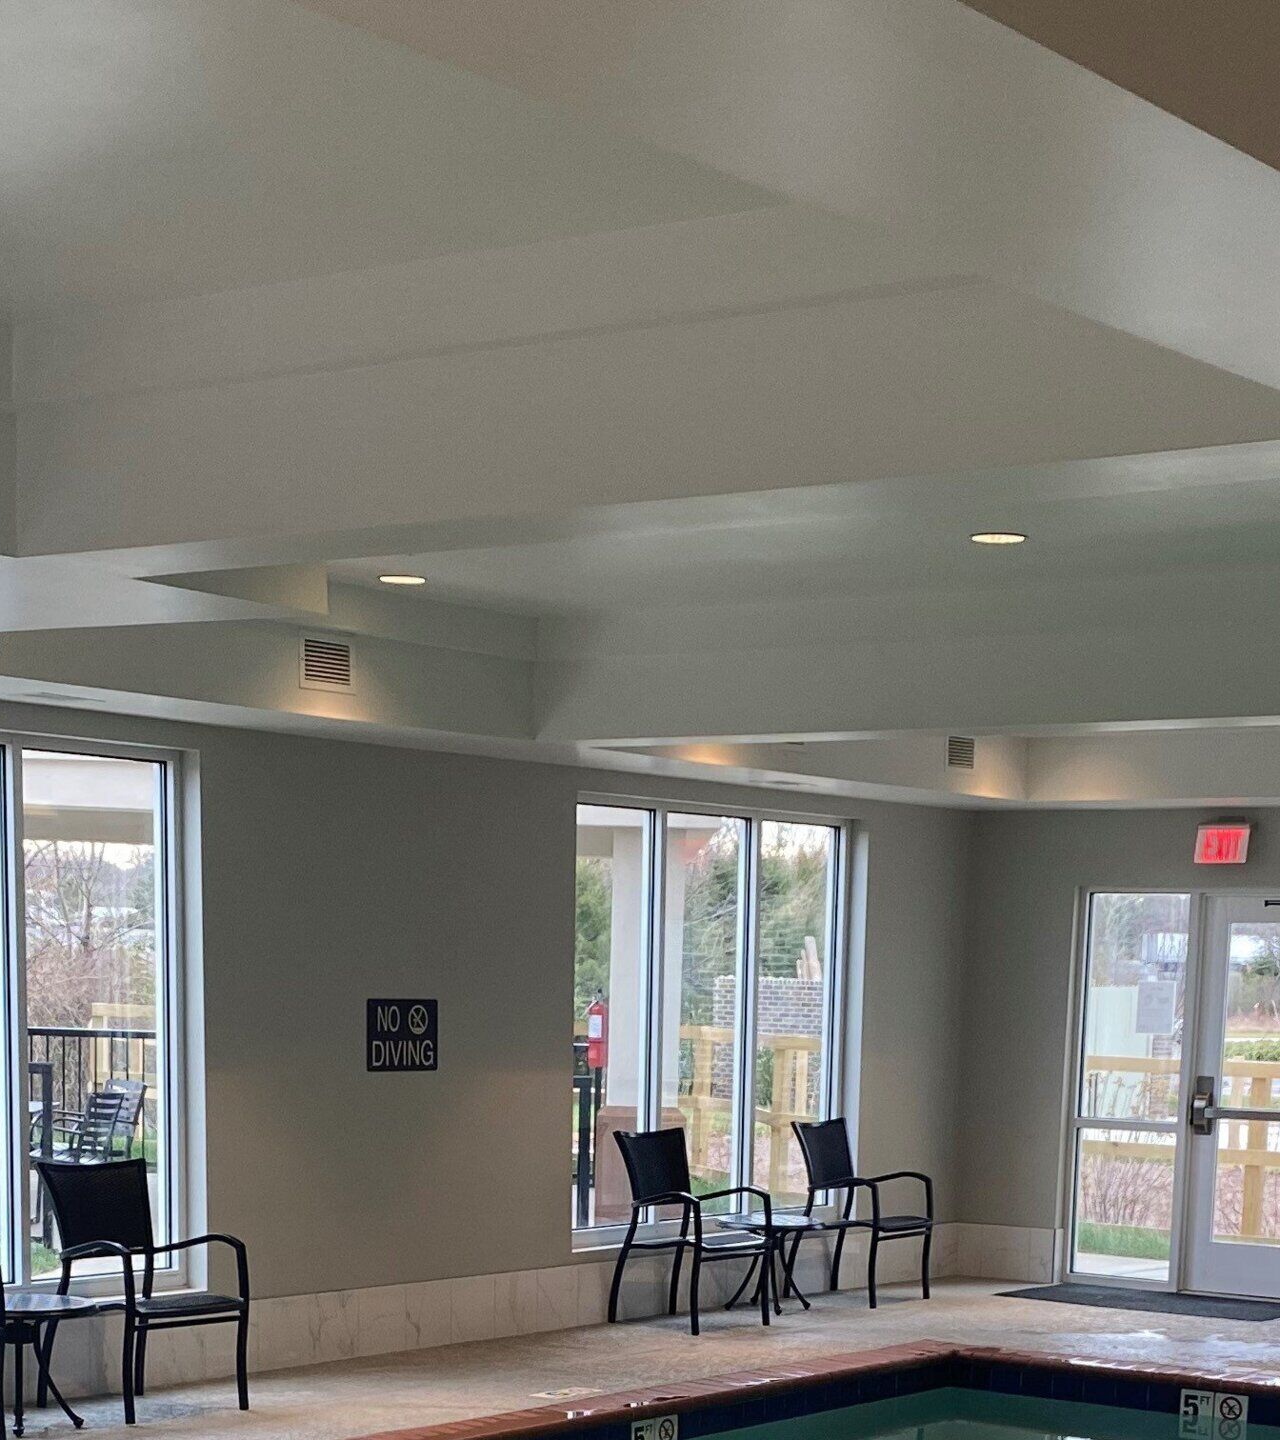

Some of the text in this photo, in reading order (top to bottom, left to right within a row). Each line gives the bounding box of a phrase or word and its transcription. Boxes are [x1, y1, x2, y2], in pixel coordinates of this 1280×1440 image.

[377, 1005, 400, 1032] NO
[372, 1040, 434, 1067] DIVING
[1184, 1394, 1211, 1416] 5 FT
